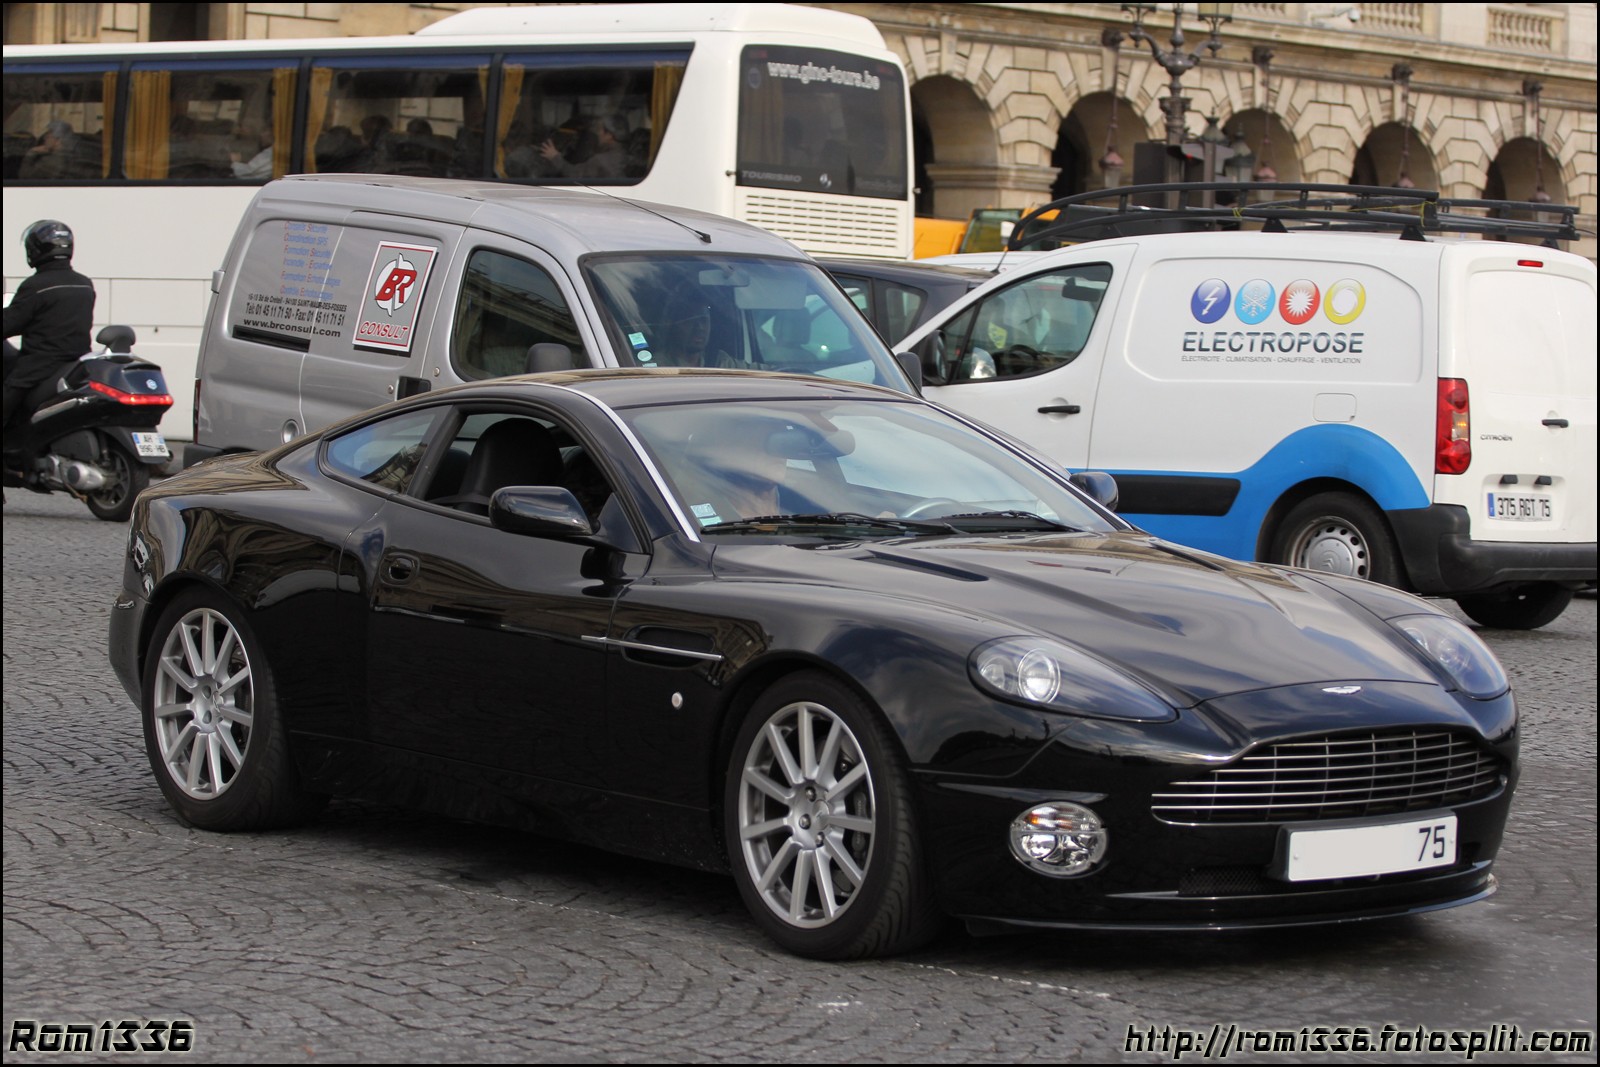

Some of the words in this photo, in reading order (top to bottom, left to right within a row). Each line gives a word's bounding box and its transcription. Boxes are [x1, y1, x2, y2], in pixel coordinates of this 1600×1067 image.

[767, 61, 880, 90] www.gino-tours.be
[375, 267, 417, 304] BR
[244, 319, 341, 337] www.brconsult.com
[360, 320, 409, 339] CONSULT
[1182, 331, 1364, 353] ELECTROPOSE
[1497, 497, 1516, 516] 375
[1519, 498, 1536, 517] RGT
[1539, 499, 1551, 517] 75
[1418, 825, 1446, 862] 75
